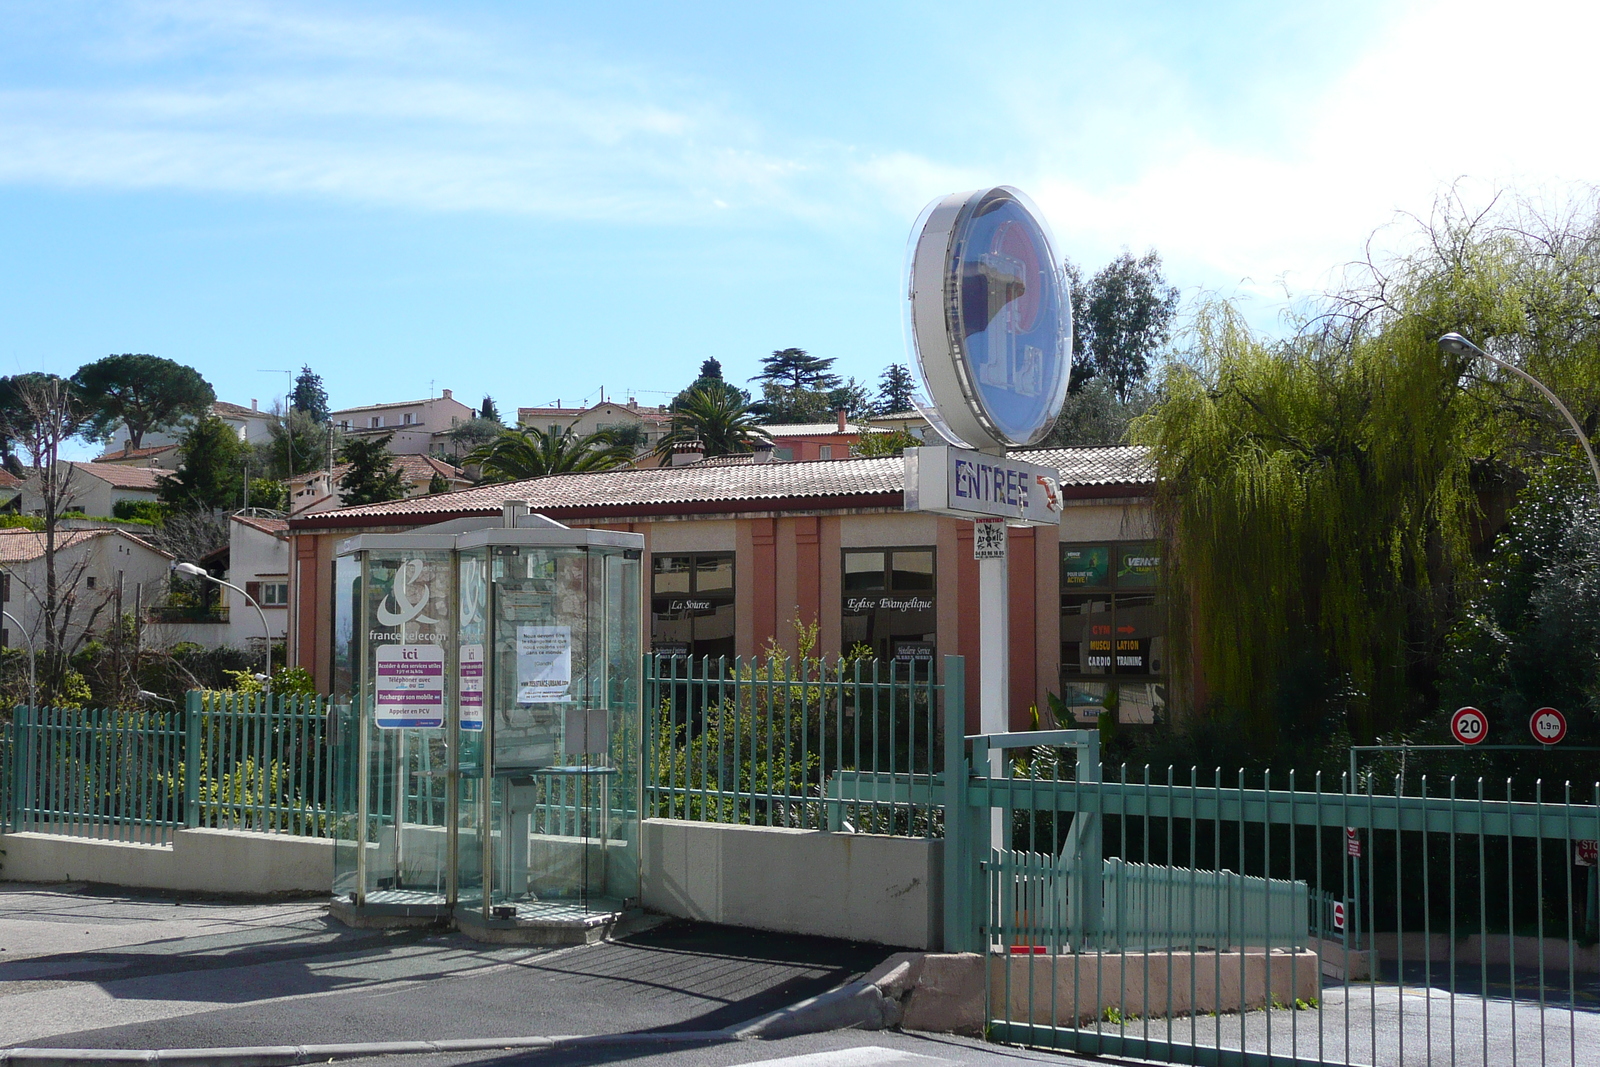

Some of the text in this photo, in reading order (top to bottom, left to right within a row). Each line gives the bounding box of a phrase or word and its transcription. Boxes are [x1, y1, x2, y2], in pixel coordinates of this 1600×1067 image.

[955, 459, 1029, 508] ENTREE
[671, 600, 710, 610] La Source
[847, 598, 876, 613] Eglise
[369, 630, 446, 641] france telecom
[1092, 625, 1111, 635] GYM
[1090, 640, 1139, 651] MUSCU LATION
[402, 648, 418, 660] ici
[1088, 656, 1142, 667] CARDIO TRAINING
[388, 676, 417, 684] Téléphoner
[379, 694, 406, 702] Recharger
[1460, 720, 1480, 733] 20
[1539, 721, 1552, 730] 1.9
[1582, 840, 1598, 851] STO
